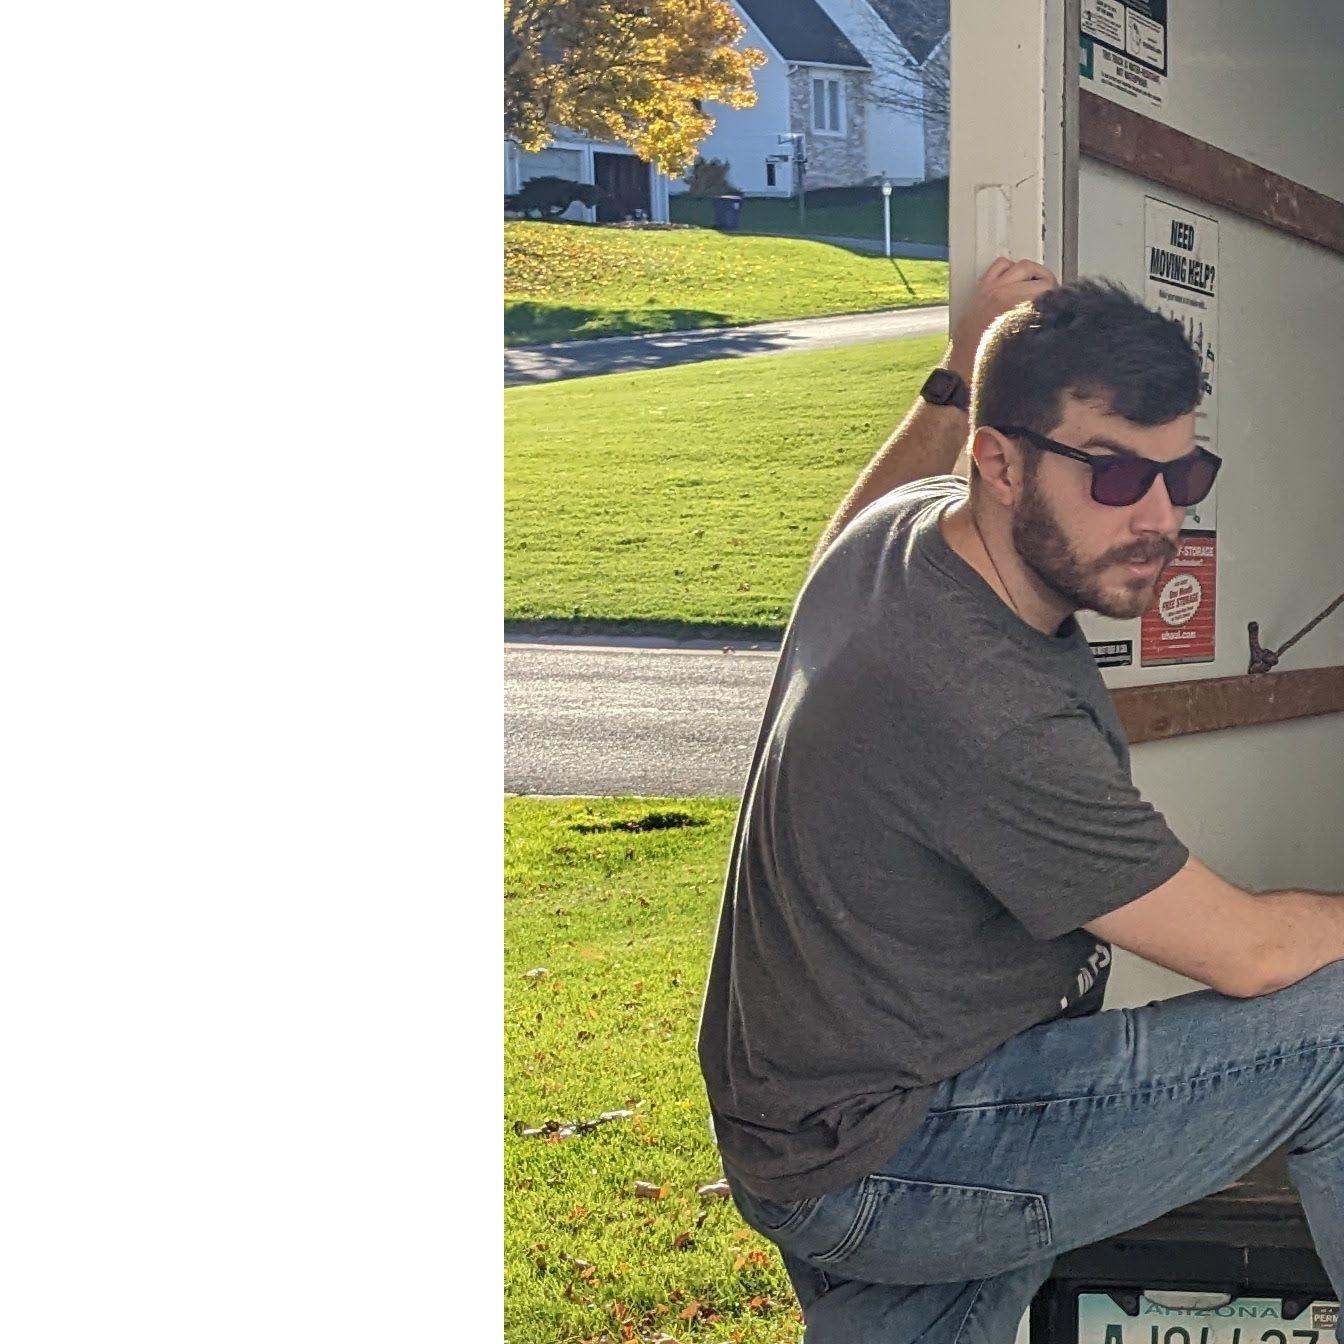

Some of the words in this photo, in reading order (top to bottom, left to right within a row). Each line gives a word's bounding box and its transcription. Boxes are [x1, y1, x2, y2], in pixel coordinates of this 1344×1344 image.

[1170, 219, 1195, 252] NEED
[1150, 246, 1187, 284] MOVING
[1187, 258, 1216, 292] HELP?
[1178, 544, 1215, 557] F-STORAGE
